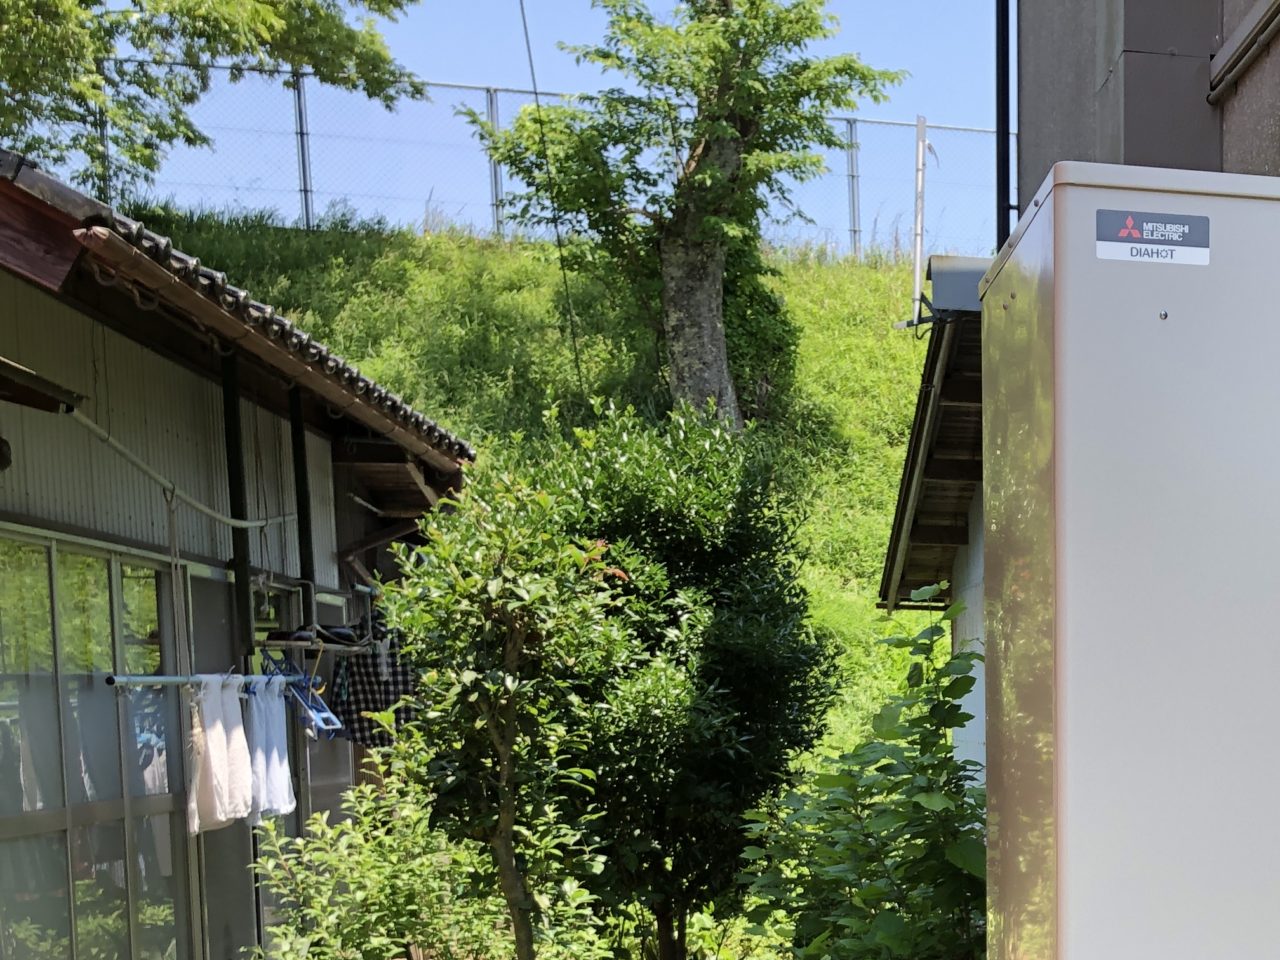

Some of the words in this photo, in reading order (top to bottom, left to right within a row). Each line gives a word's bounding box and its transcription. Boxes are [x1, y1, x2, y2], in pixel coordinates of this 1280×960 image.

[1143, 222, 1189, 233] MITSUBISHI
[1143, 230, 1183, 241] ELECTRIC
[1130, 247, 1175, 259] DIAHOT
